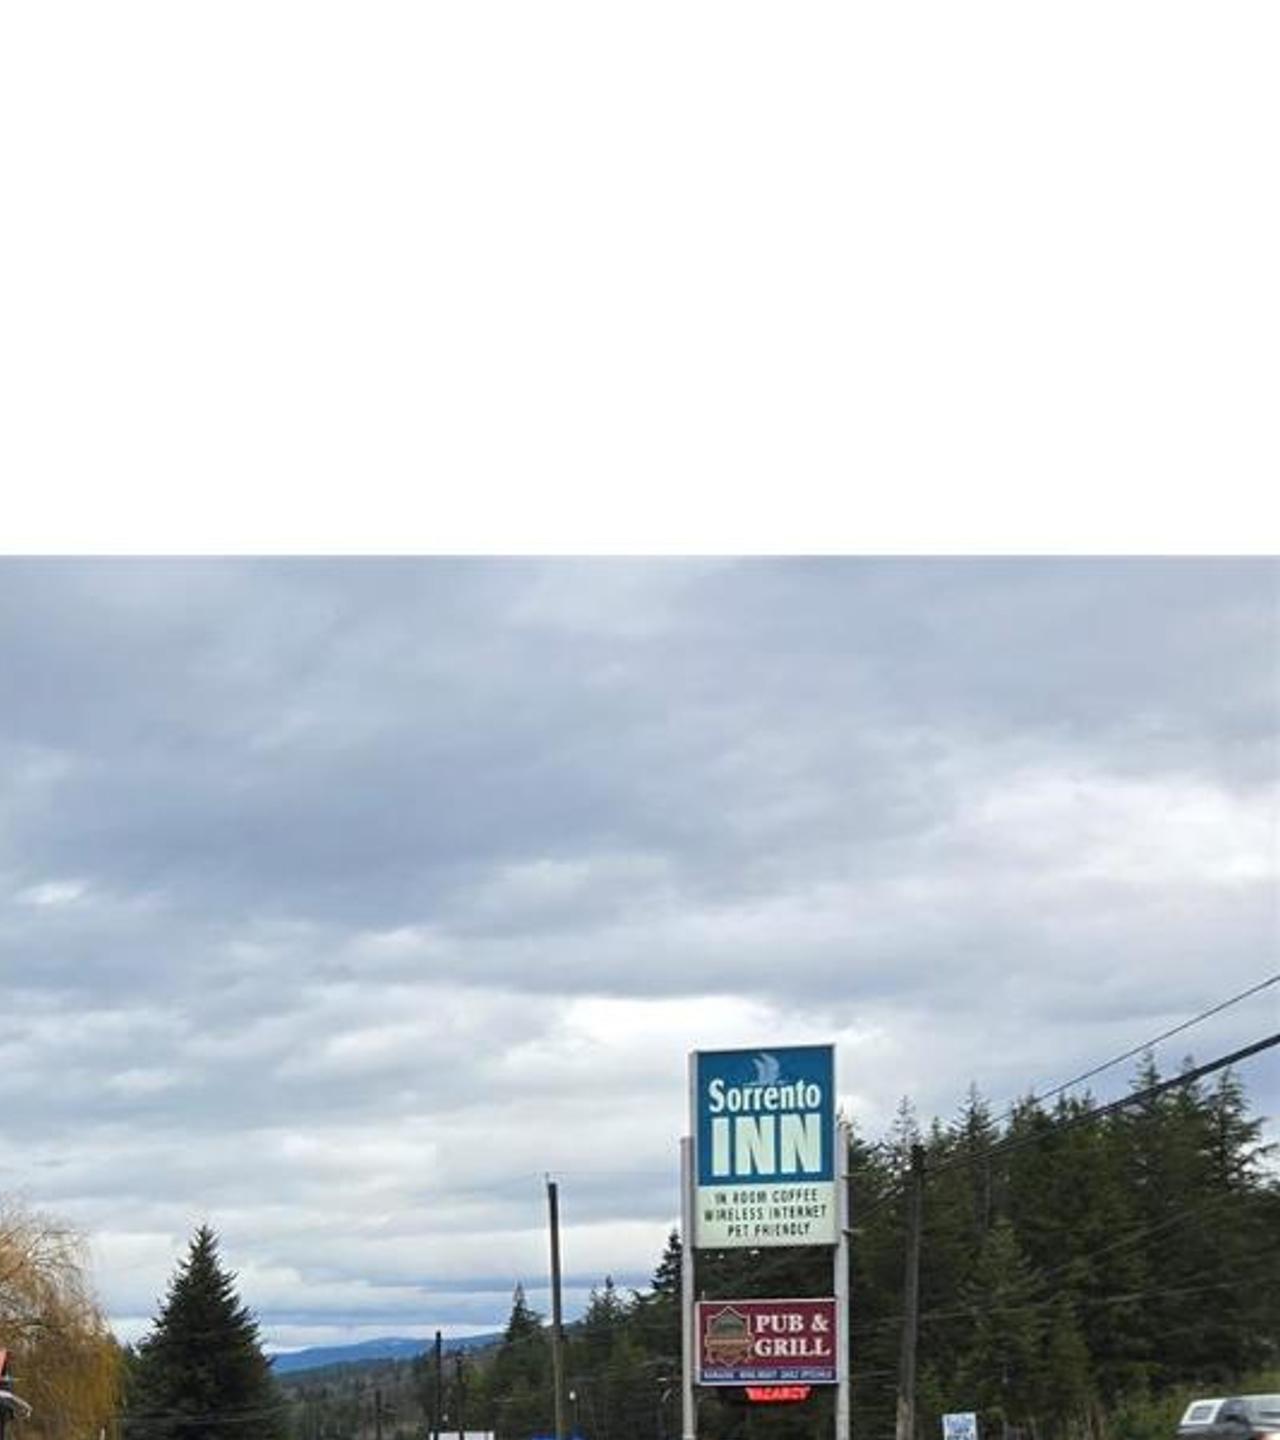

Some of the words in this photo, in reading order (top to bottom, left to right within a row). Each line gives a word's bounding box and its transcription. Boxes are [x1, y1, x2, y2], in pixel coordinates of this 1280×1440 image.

[708, 1077, 822, 1113] Sorrento
[711, 1112, 823, 1177] INN
[715, 1191, 727, 1204] IN
[733, 1190, 768, 1204] ROOM
[772, 1188, 818, 1203] COFFEE
[704, 1206, 764, 1222] WIRELESS
[769, 1203, 827, 1220] INTERNET
[727, 1223, 749, 1237] PET
[754, 1221, 811, 1237] FRIENDLY
[754, 1314, 805, 1334] PUB
[810, 1313, 829, 1332] &
[753, 1336, 832, 1357] GRILL
